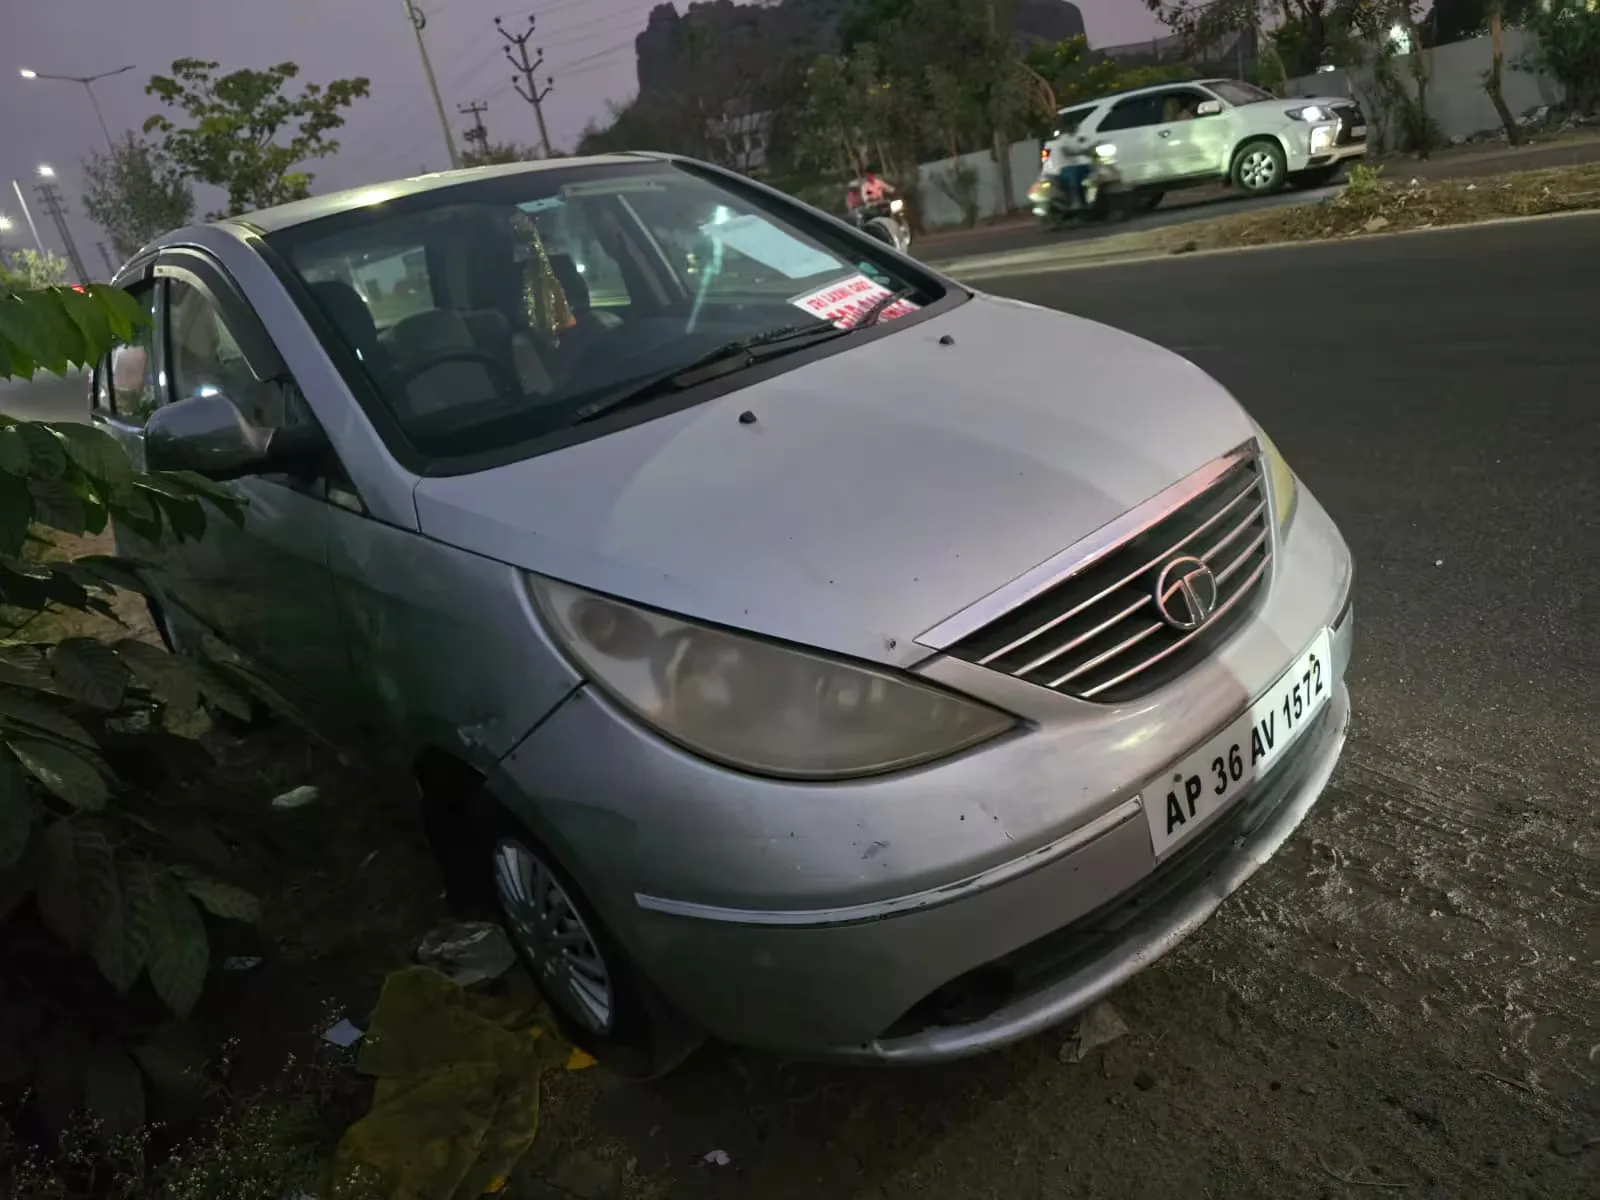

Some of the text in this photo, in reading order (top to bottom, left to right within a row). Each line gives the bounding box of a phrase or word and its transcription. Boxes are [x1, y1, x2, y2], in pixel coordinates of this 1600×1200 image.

[1165, 660, 1323, 835] AP 36 AV 1572
